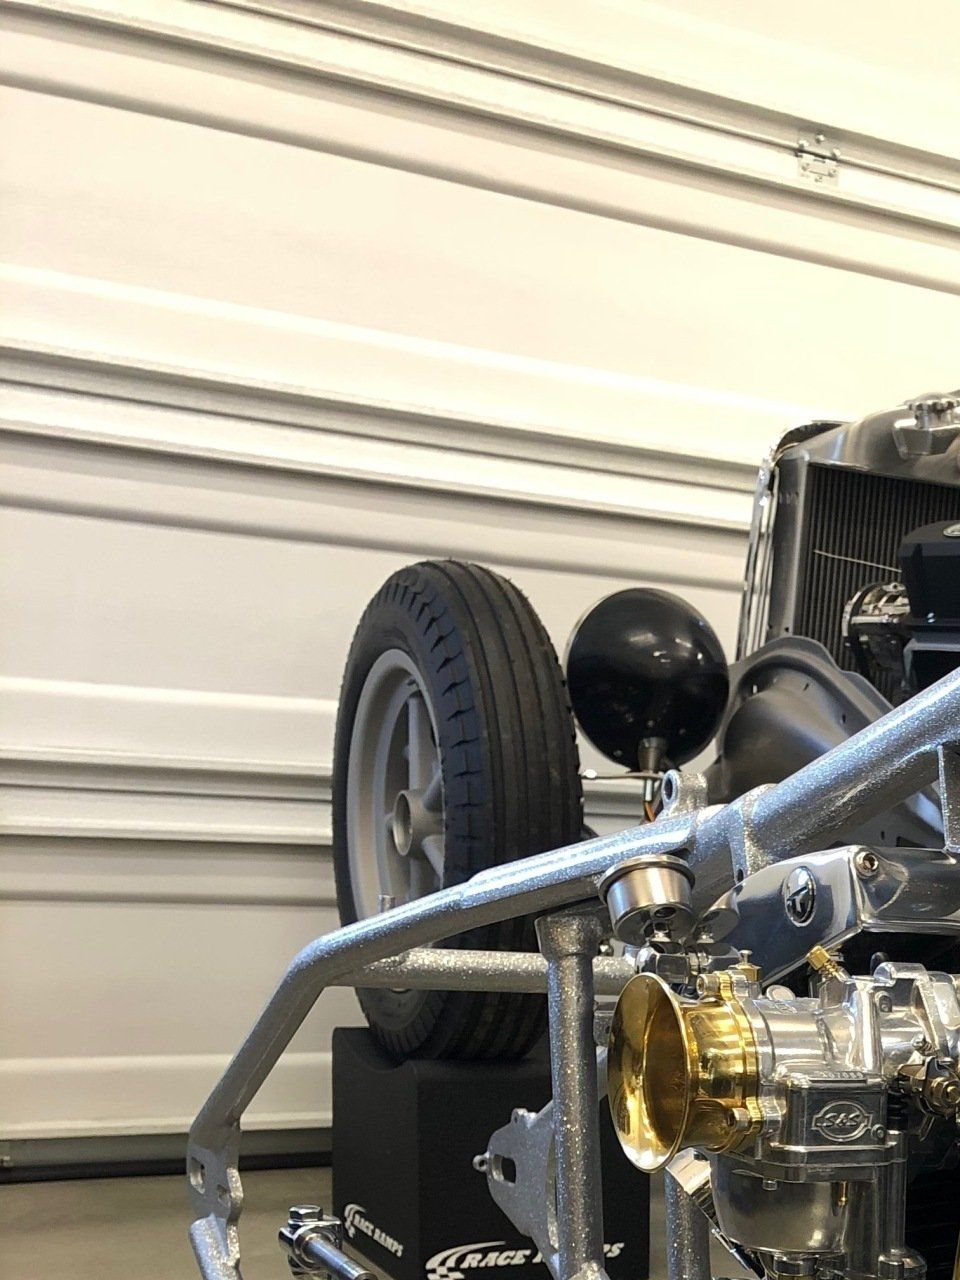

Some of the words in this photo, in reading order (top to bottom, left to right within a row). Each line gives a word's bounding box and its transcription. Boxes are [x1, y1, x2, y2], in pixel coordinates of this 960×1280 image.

[816, 1111, 863, 1127] S&S
[353, 1213, 375, 1237] RACE
[373, 1228, 403, 1257] RAMPS
[460, 1249, 531, 1269] RACE
